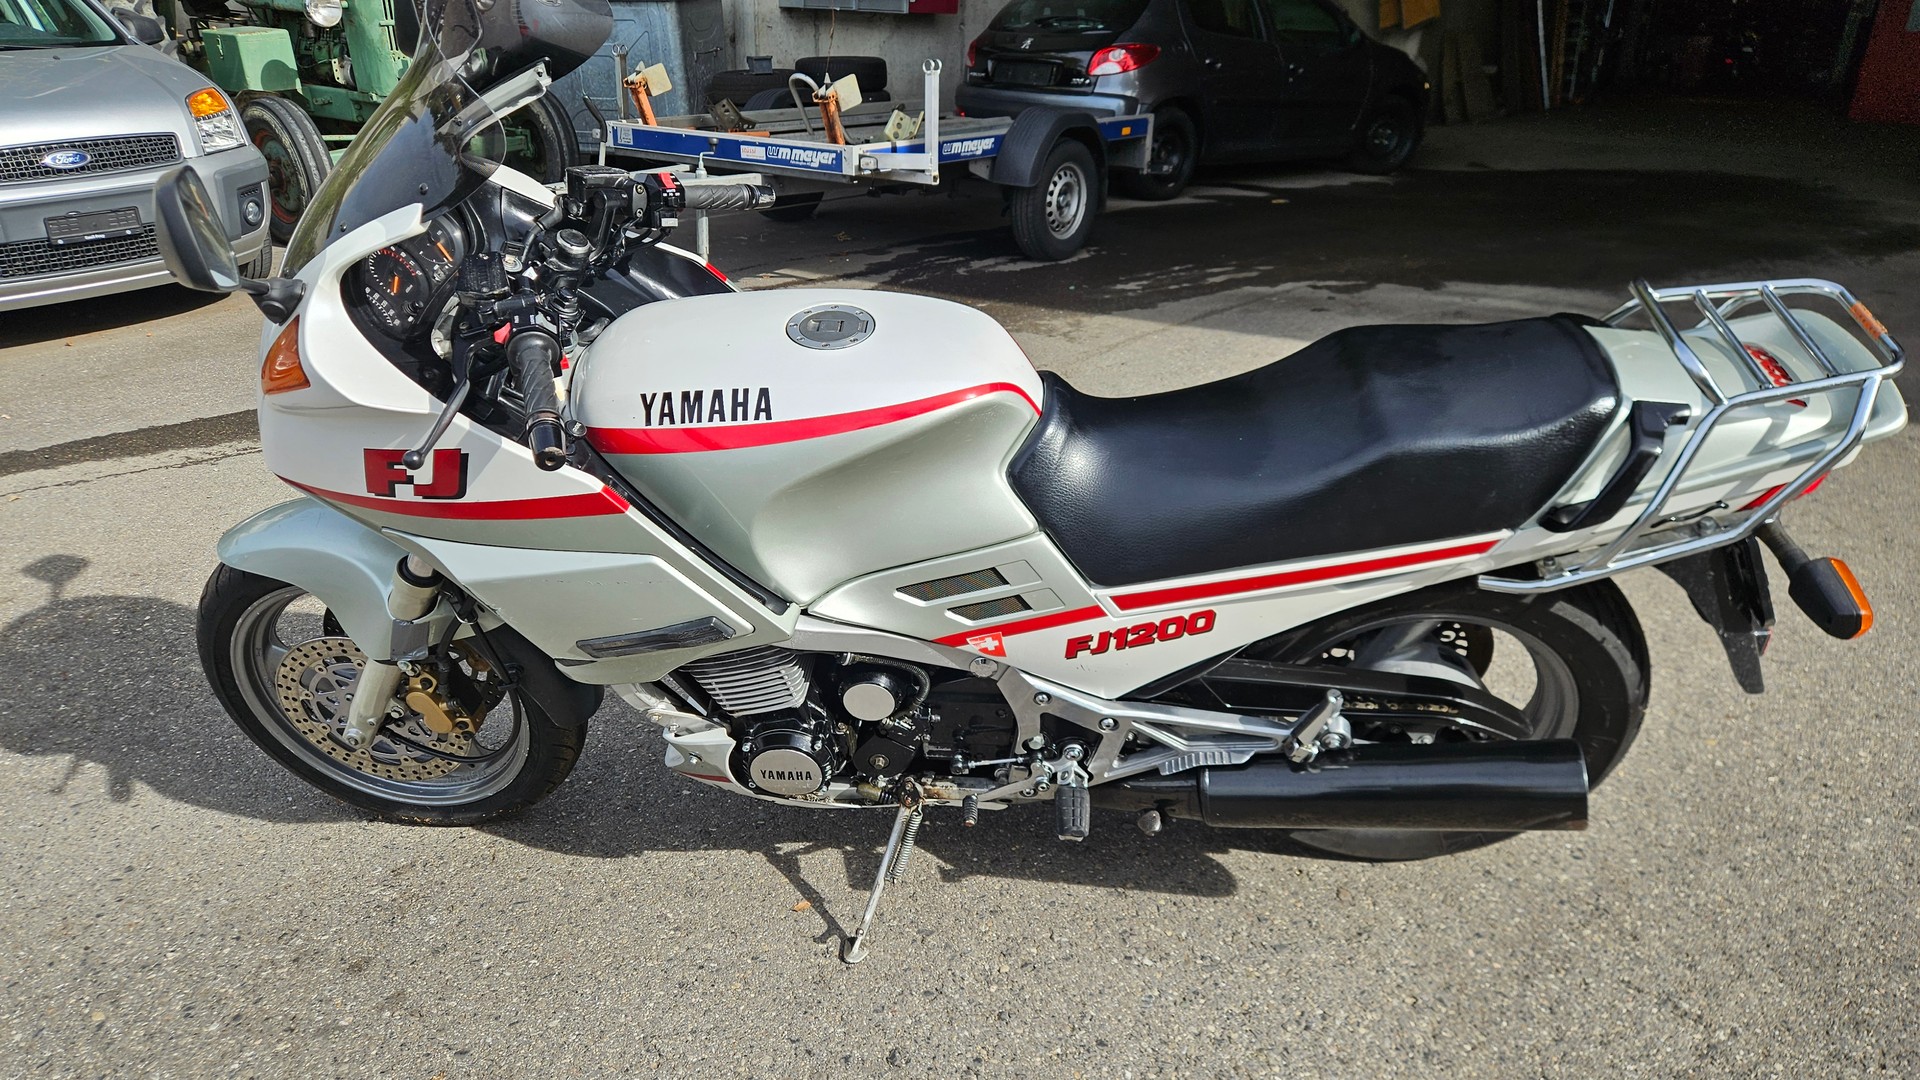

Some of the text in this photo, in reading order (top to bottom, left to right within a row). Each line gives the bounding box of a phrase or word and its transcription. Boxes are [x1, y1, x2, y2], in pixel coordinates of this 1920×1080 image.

[56, 154, 80, 164] Ford
[640, 387, 773, 427] YAMAHA
[363, 448, 470, 500] FJ
[1064, 609, 1217, 659] FJ1200
[760, 769, 813, 781] YAMAHA
